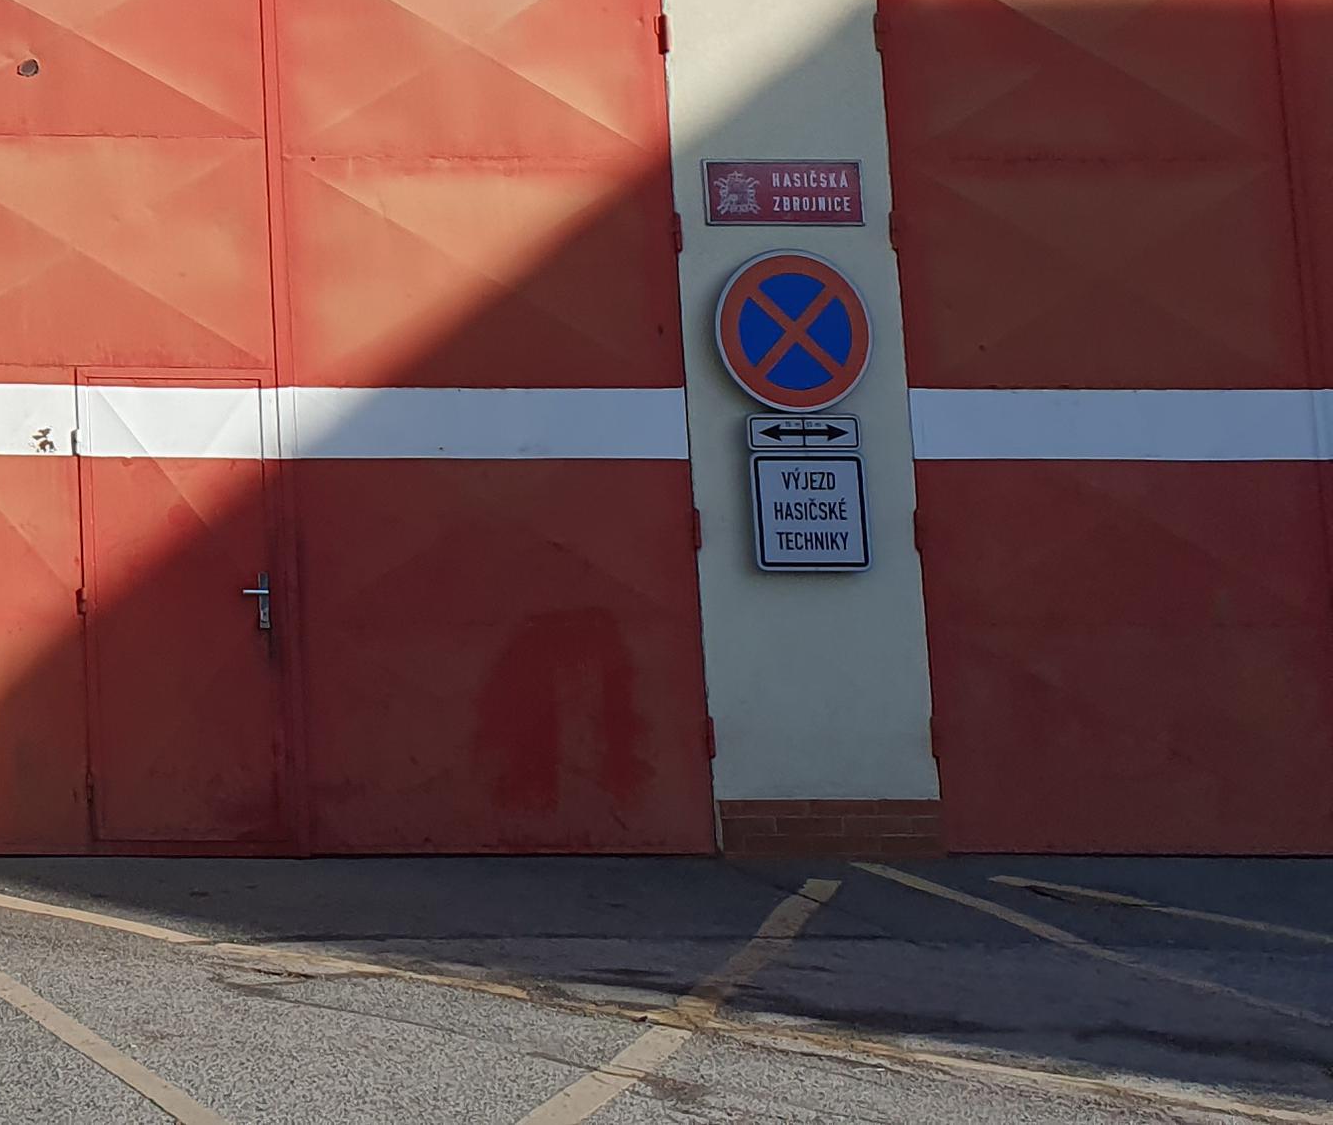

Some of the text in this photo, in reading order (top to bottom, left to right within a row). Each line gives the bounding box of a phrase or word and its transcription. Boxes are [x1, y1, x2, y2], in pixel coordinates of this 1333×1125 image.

[772, 170, 849, 188] HASIČSKÁ
[772, 196, 852, 212] ZBROJNICE
[781, 467, 836, 491] VÝJEZD
[773, 497, 848, 521] HASIČSKÉ
[776, 531, 849, 551] TECHNIKY
